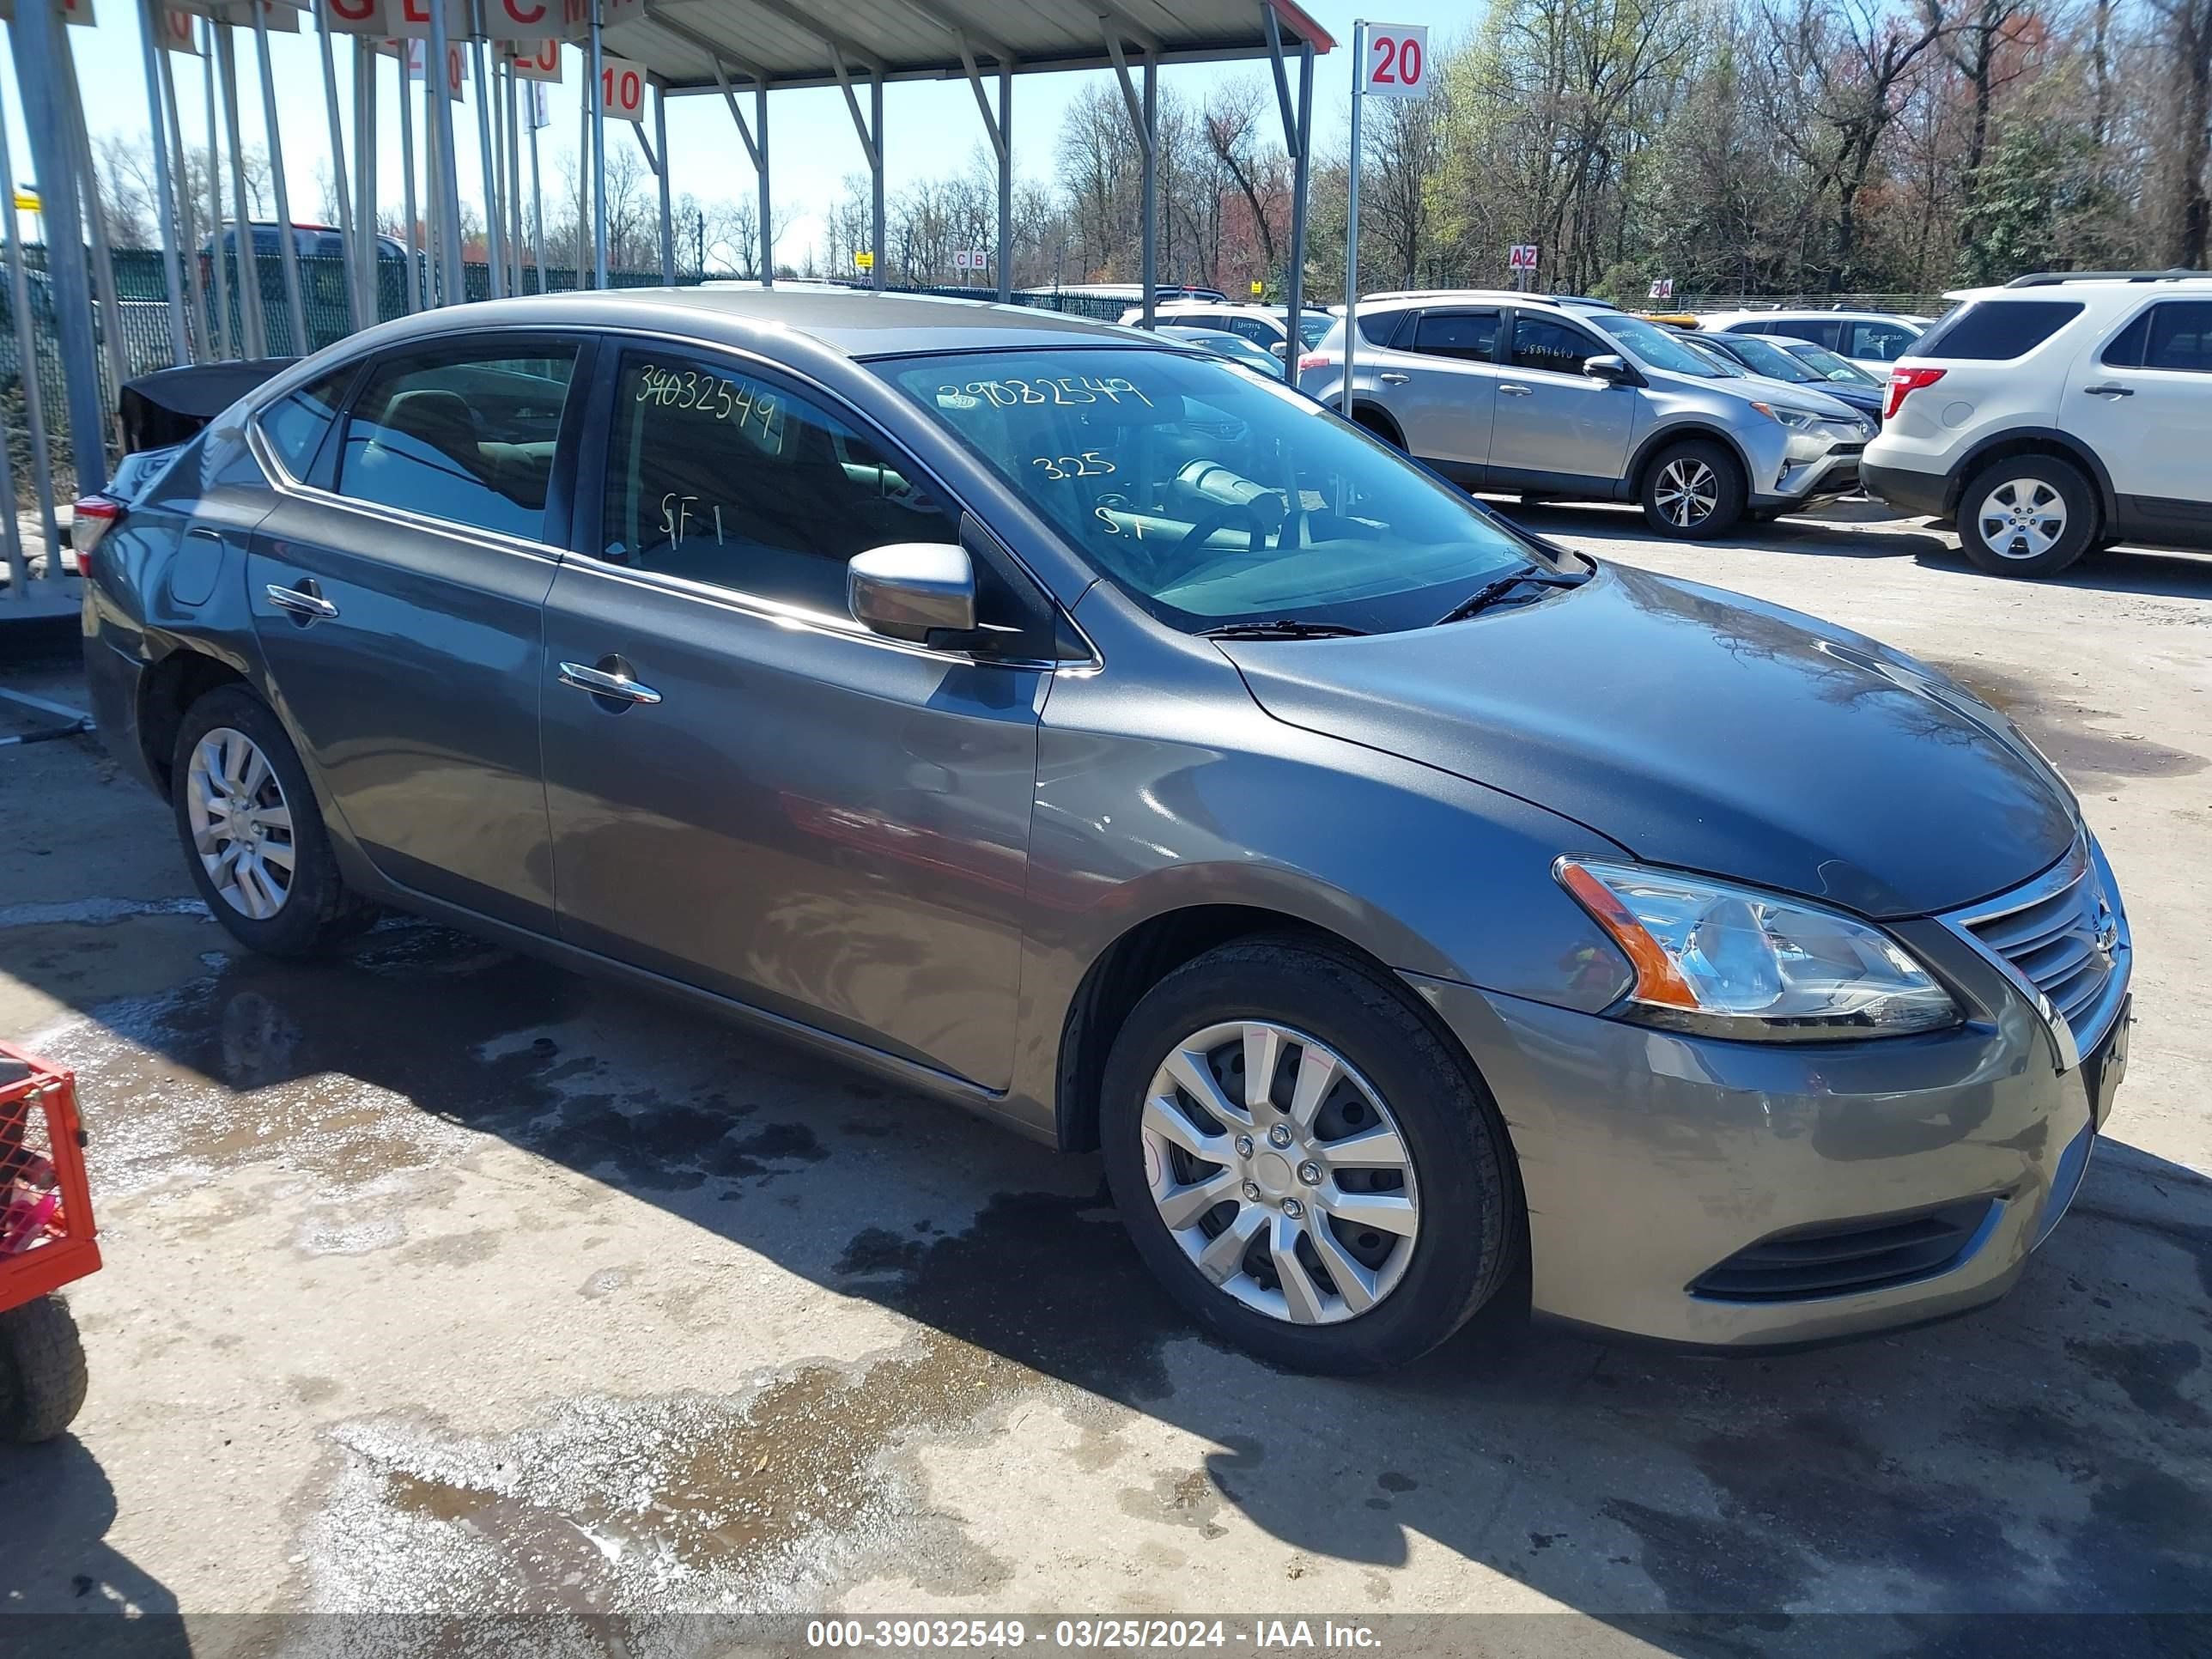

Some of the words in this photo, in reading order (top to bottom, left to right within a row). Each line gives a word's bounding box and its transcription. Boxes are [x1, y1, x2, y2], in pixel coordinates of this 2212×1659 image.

[1372, 37, 1421, 84] 20
[603, 68, 640, 110] 10
[957, 253, 966, 266] C
[975, 254, 983, 266] B
[1032, 452, 1115, 480] 3.25
